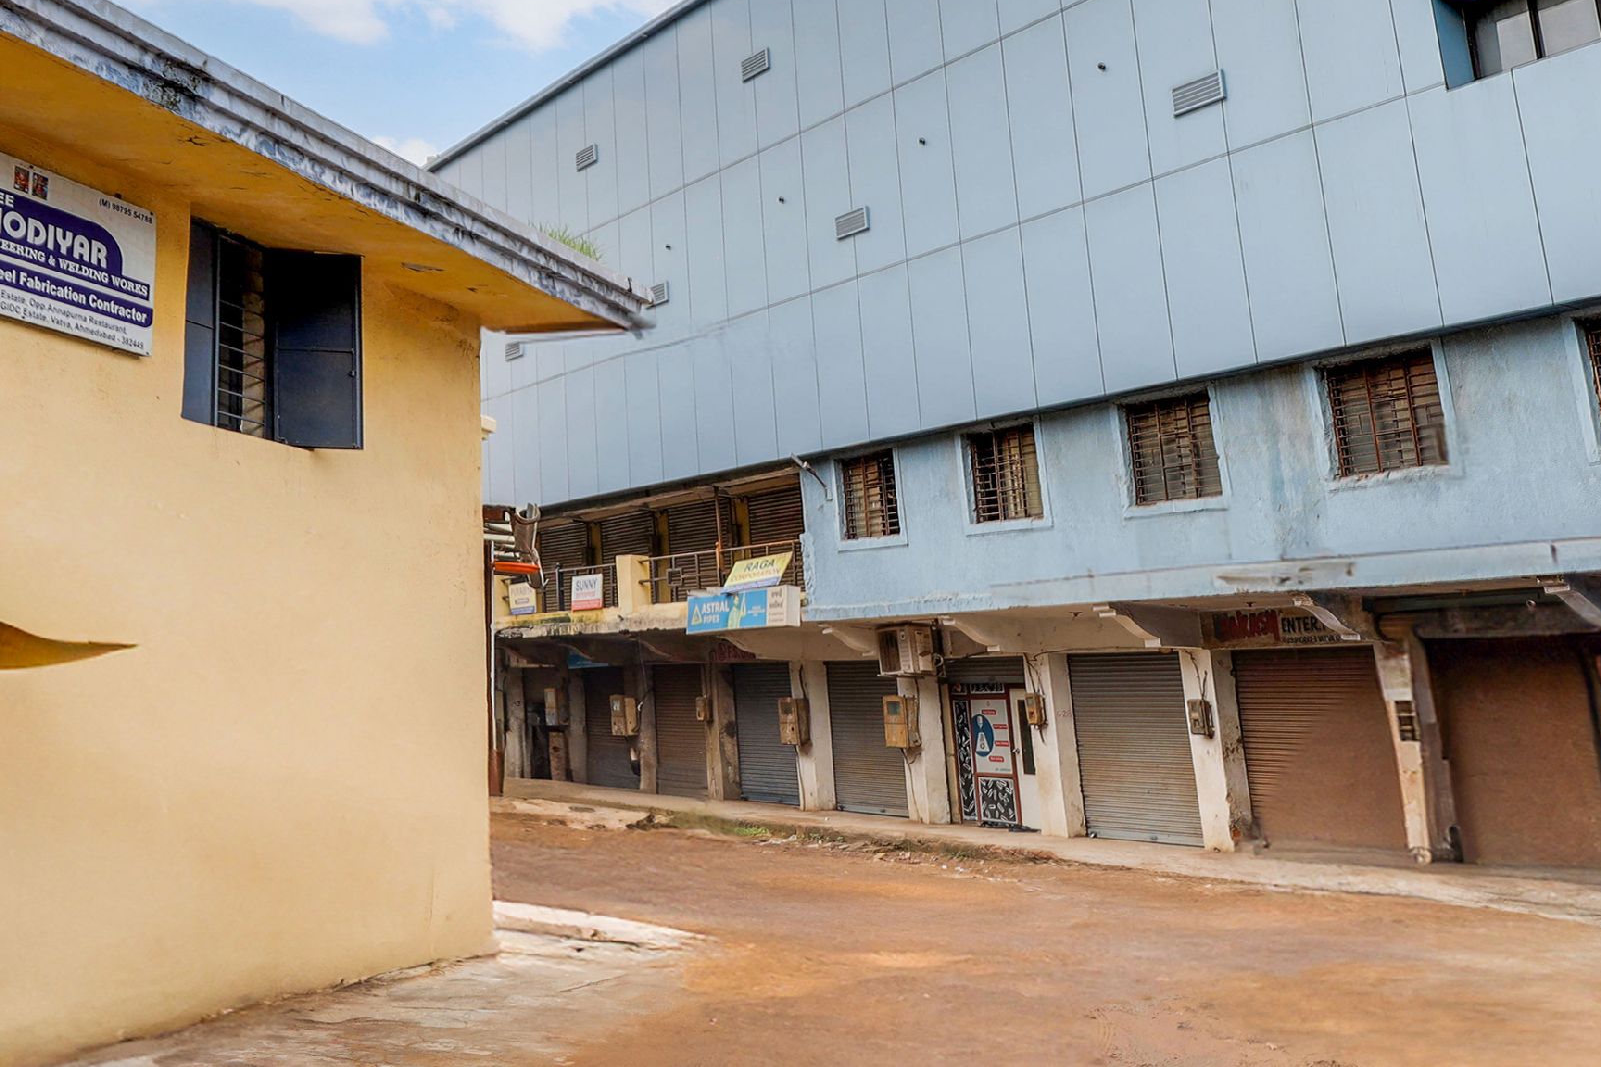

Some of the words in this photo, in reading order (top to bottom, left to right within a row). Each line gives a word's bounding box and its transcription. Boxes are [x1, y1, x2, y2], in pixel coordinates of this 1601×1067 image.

[0, 207, 108, 269] ODIYAR
[20, 271, 87, 305] Fabrication
[89, 293, 148, 323] Contractor
[48, 254, 56, 267] &
[58, 257, 109, 284] WELDING
[111, 274, 149, 297] WORKS
[575, 578, 597, 592] SUNNY
[702, 600, 730, 614] ASTRAL
